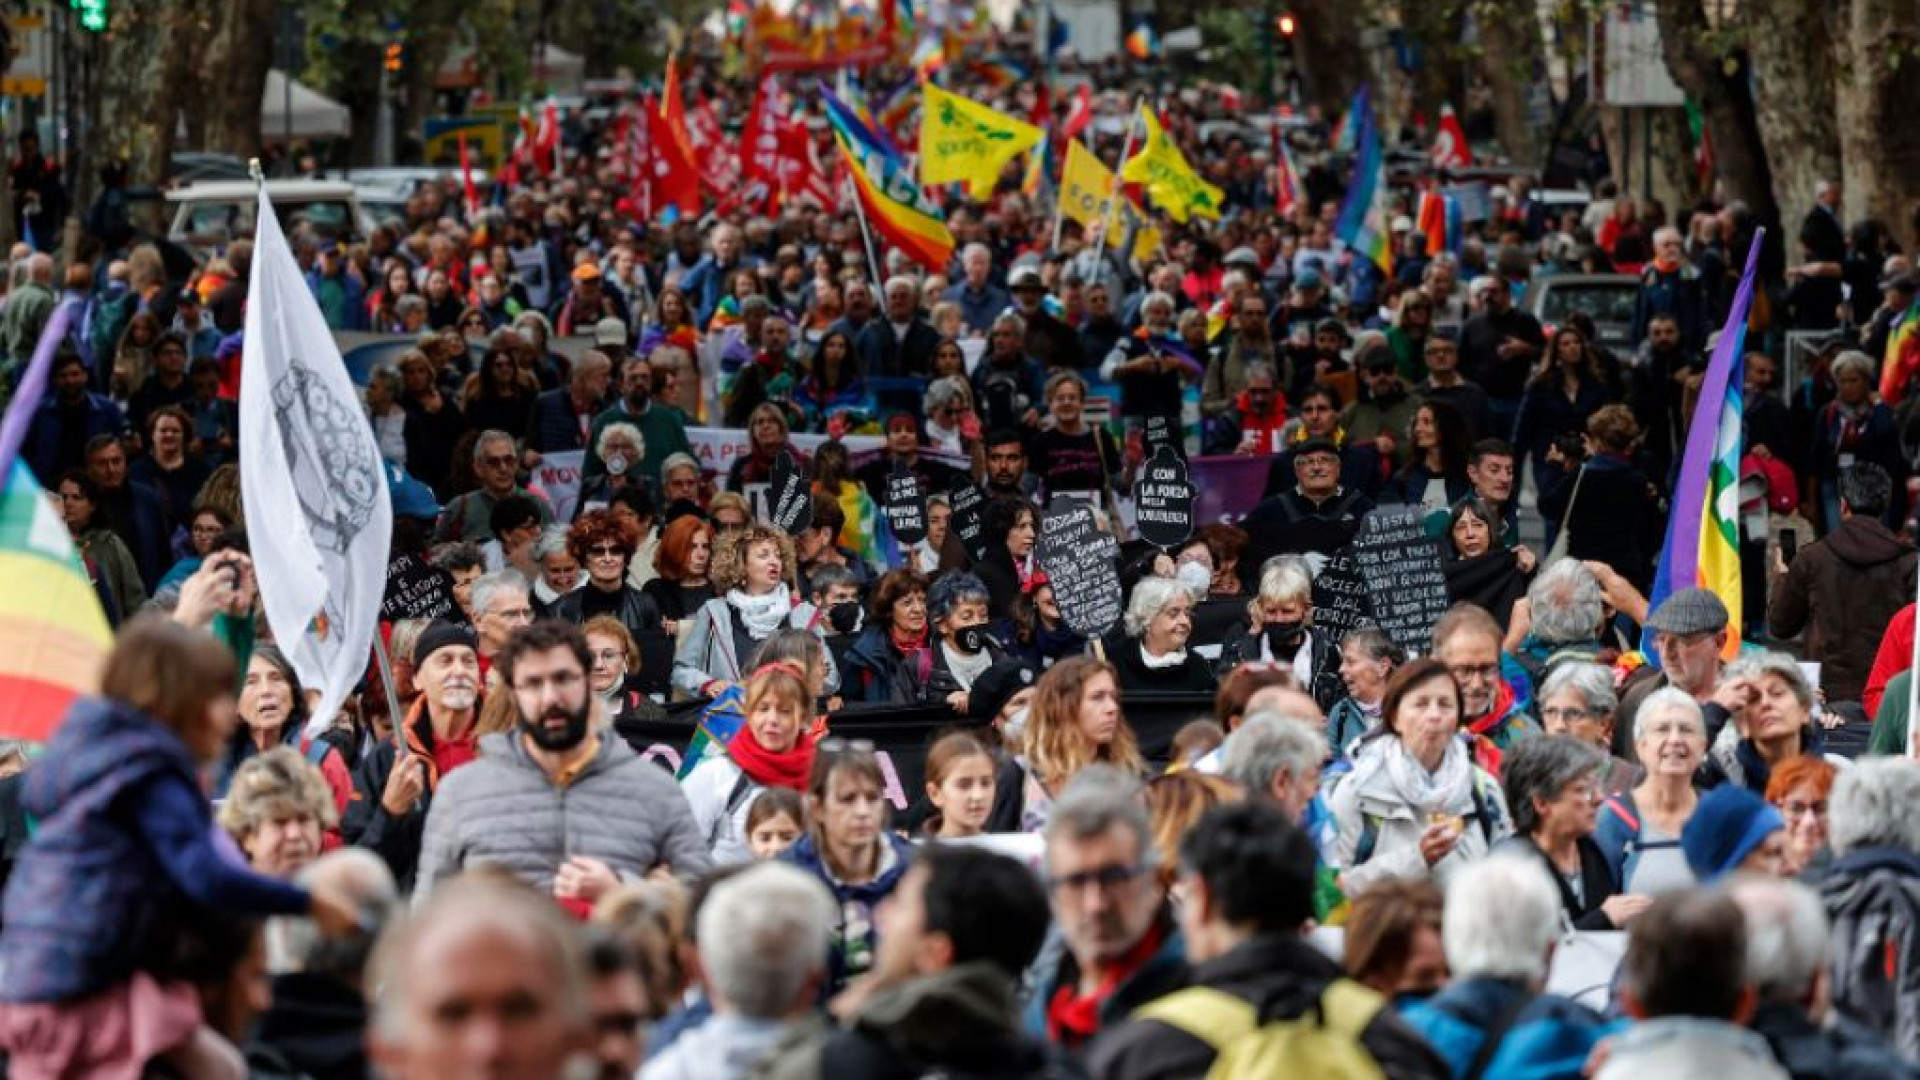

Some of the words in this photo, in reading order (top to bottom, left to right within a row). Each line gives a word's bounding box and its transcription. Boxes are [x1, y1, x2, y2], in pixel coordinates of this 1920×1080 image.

[1153, 468, 1176, 480] CON
[1142, 483, 1155, 497] LA
[1158, 484, 1190, 499] FORZA
